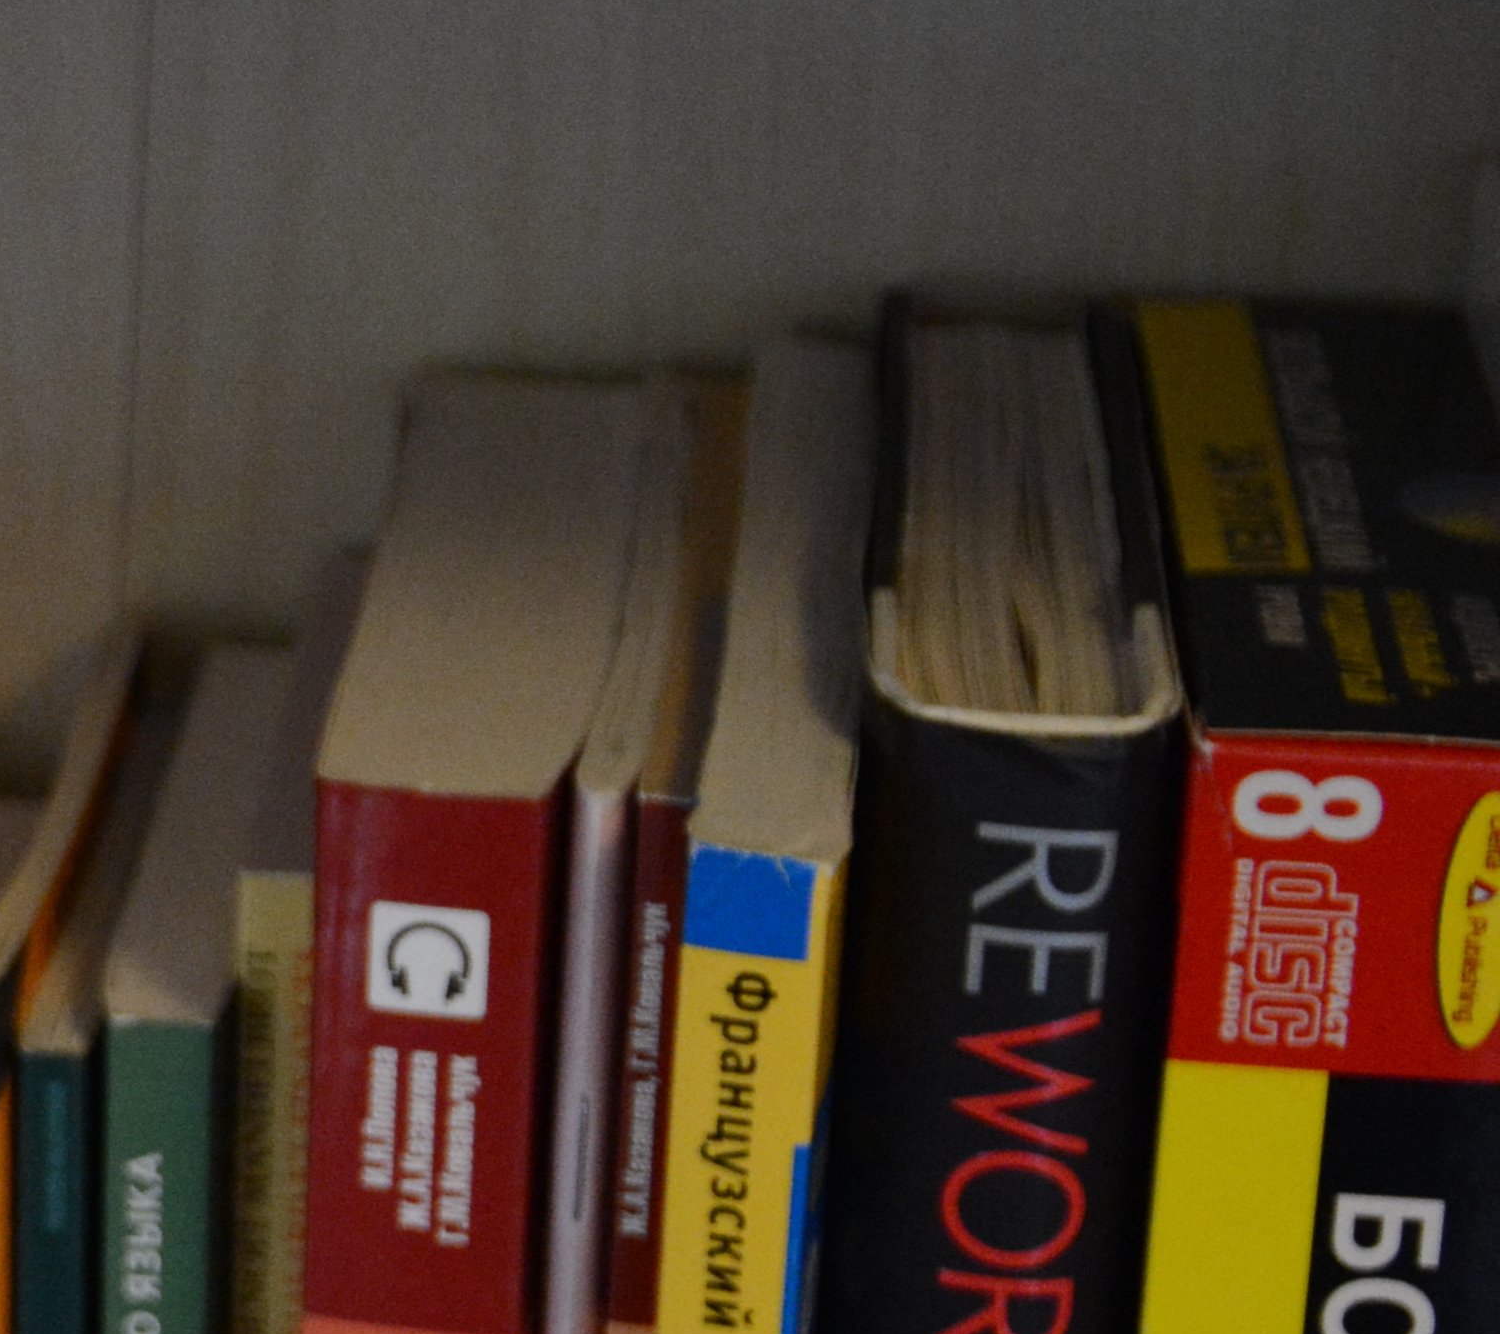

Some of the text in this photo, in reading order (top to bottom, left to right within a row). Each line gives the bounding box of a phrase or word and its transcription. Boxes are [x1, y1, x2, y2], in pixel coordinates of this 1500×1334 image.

[1232, 769, 1384, 843] 8
[1218, 857, 1255, 1041] DIGITAL AUDIO
[1242, 858, 1360, 1049] disc
[1323, 916, 1360, 1049] COMPACT
[1451, 915, 1487, 1024] Publishing
[125, 1151, 166, 1305] ЯЗЫКА
[693, 971, 779, 1332] Французский
